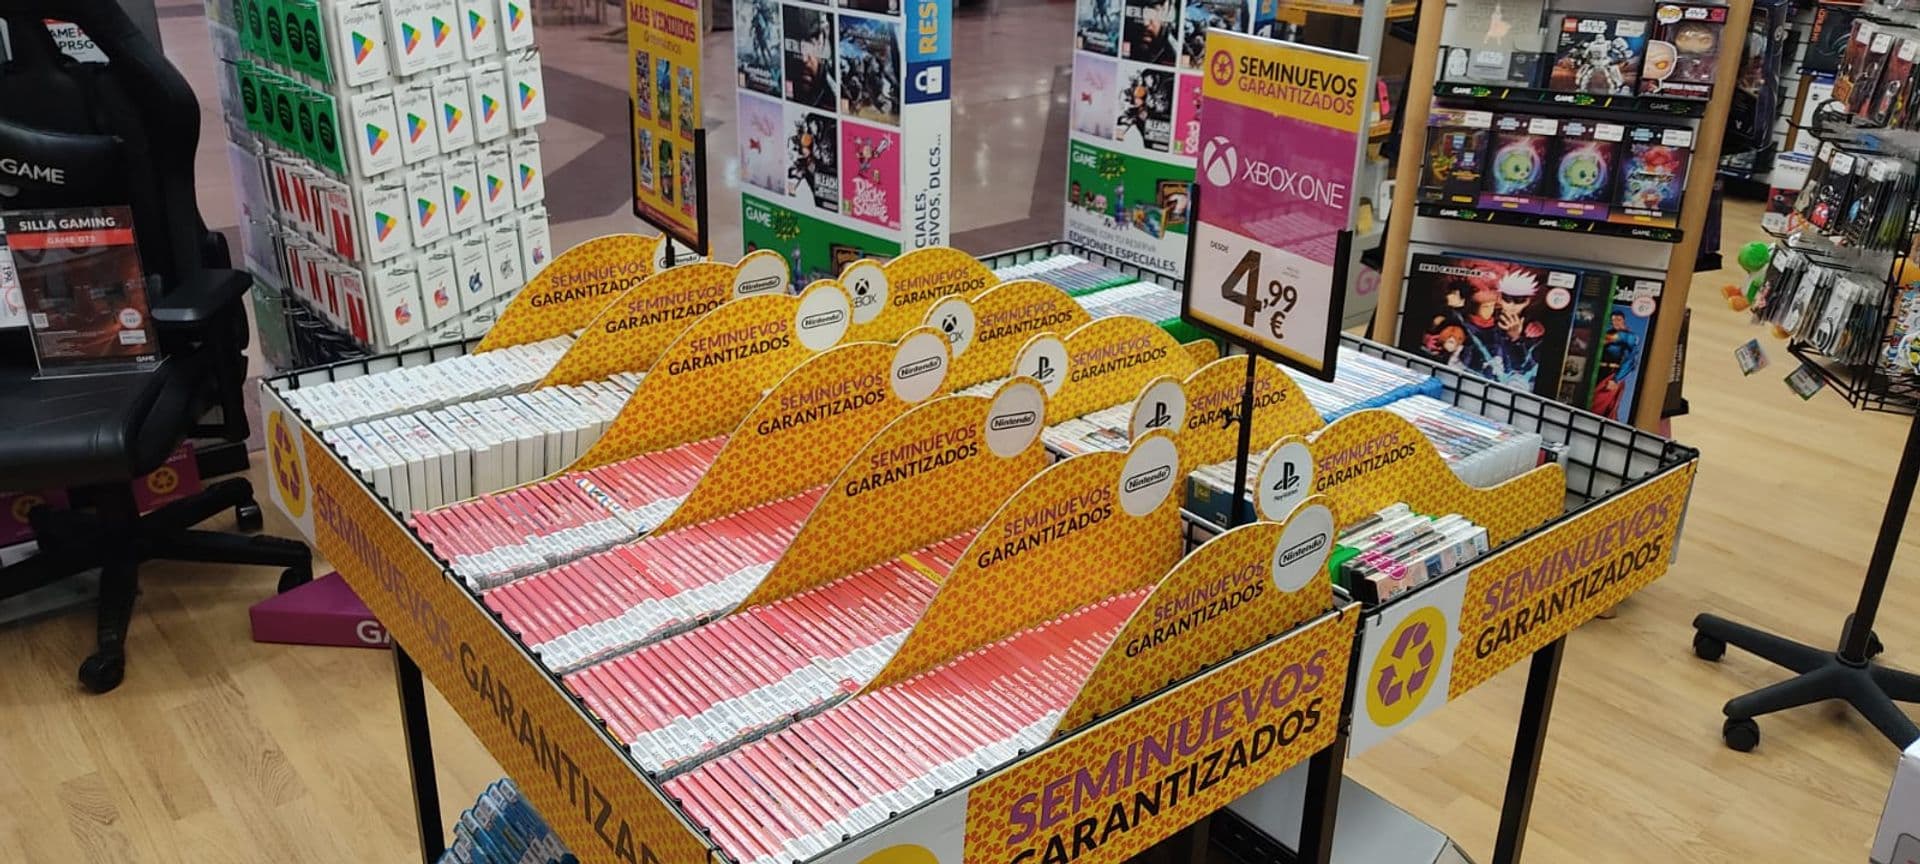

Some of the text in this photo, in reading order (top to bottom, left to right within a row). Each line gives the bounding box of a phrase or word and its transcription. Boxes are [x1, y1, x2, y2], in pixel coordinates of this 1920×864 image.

[1239, 56, 1358, 98] SEMINUEVOS
[1238, 77, 1355, 116] GARANTIZADOS
[1, 158, 65, 185] GAME
[1242, 157, 1345, 210] XBOX ONE
[19, 217, 116, 232] SILLA GAMING
[746, 206, 772, 227] GAME
[1068, 230, 1114, 256] EDICIONES
[552, 260, 647, 288] SEMINUEVOS
[894, 266, 970, 293] SEMINUEVOS
[894, 278, 986, 307] GARANTIZADOS
[628, 284, 726, 315] SEMINUEVOS
[852, 294, 877, 308] BOX
[979, 300, 1057, 328] SEMINUEVOS
[690, 319, 788, 354] SEMINUEVOS
[978, 310, 1072, 343] GARANTIZADOS
[1270, 311, 1286, 339] €
[668, 335, 790, 376] GARANTIZADOS
[1072, 336, 1151, 367] SEMINUEVOS
[1072, 346, 1168, 383] GARANTIZADOS
[780, 372, 884, 412] SEMINUEVOS
[757, 388, 885, 436] GARANTIZADOS
[994, 416, 1032, 428] Nintendo
[870, 424, 977, 471] SEMINUEVOS
[1318, 432, 1399, 474] SEMINUEVOS
[846, 442, 978, 498] GARANTIZADOS
[1128, 469, 1168, 488] Nintendo
[1316, 442, 1416, 492] GARANTIZADOS
[1004, 485, 1112, 539] SEMINUEVOS
[977, 503, 1112, 570] GARANTIZADOS
[1282, 538, 1324, 563] Nintendo
[316, 483, 455, 663] SEMINUEVOS
[1480, 495, 1674, 622] SEMINUEVOS
[1153, 560, 1266, 624] SEMINUEVOS
[1476, 534, 1664, 660] GARANTIZADOS
[1126, 581, 1266, 659] GARANTIZADOS
[1006, 648, 1326, 846] SEMINUEVOS
